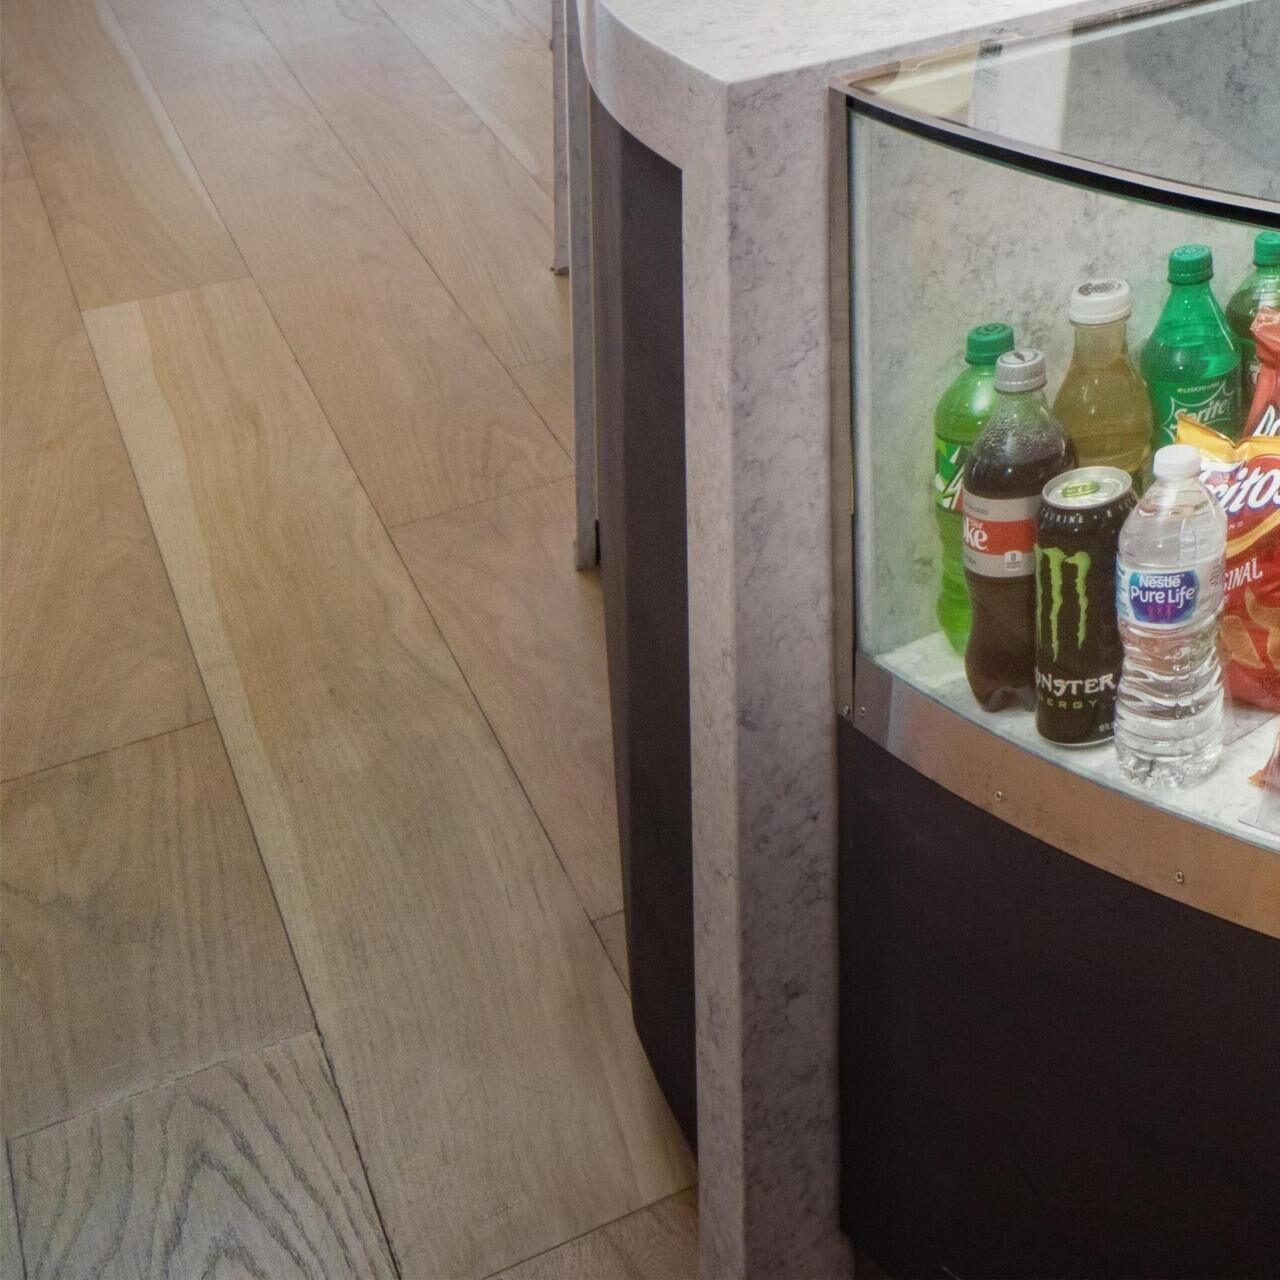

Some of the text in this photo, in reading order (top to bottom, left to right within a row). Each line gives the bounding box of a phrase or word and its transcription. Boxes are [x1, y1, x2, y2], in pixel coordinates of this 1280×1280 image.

[965, 526, 989, 551] ke
[1130, 585, 1197, 609] Pure Life
[1036, 671, 1116, 697] NSTER
